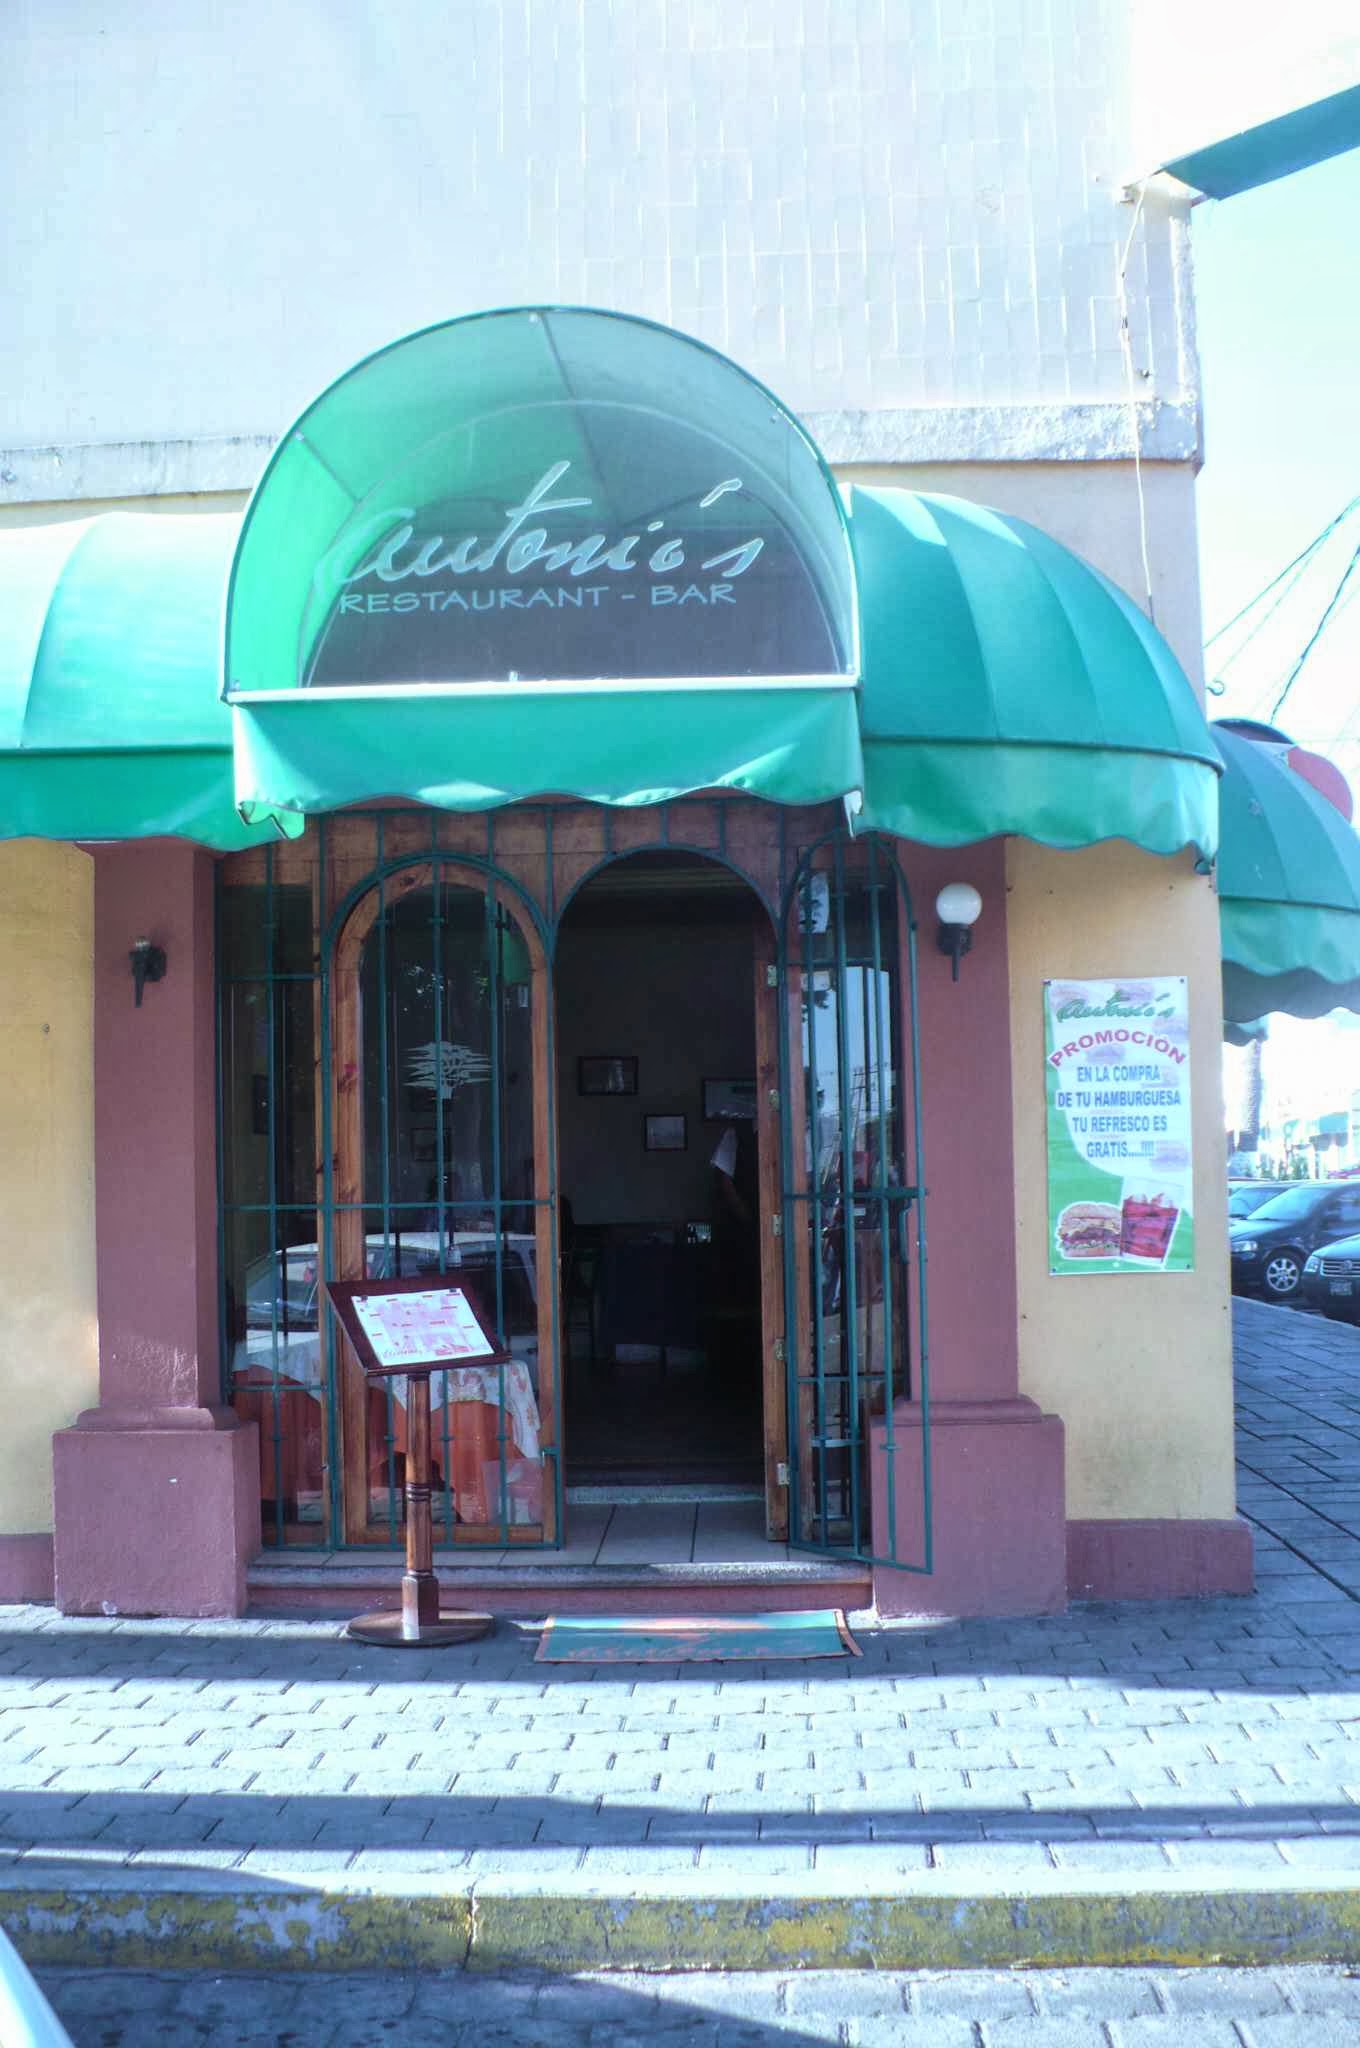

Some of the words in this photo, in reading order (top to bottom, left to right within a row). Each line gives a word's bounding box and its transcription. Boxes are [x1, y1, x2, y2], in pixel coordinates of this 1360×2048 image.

[339, 586, 609, 614] RESTAURANT
[650, 583, 737, 606] BAR
[1077, 1067, 1092, 1082] EN
[1096, 1066, 1110, 1082] LA
[1113, 1065, 1160, 1081] COMPRA
[1058, 1092, 1073, 1108] DE
[1076, 1092, 1091, 1107] TU
[1094, 1090, 1181, 1107] HAMBURGUESA
[1072, 1117, 1088, 1132] TU
[1091, 1116, 1150, 1132] REFRESCO
[1153, 1116, 1167, 1131] ES
